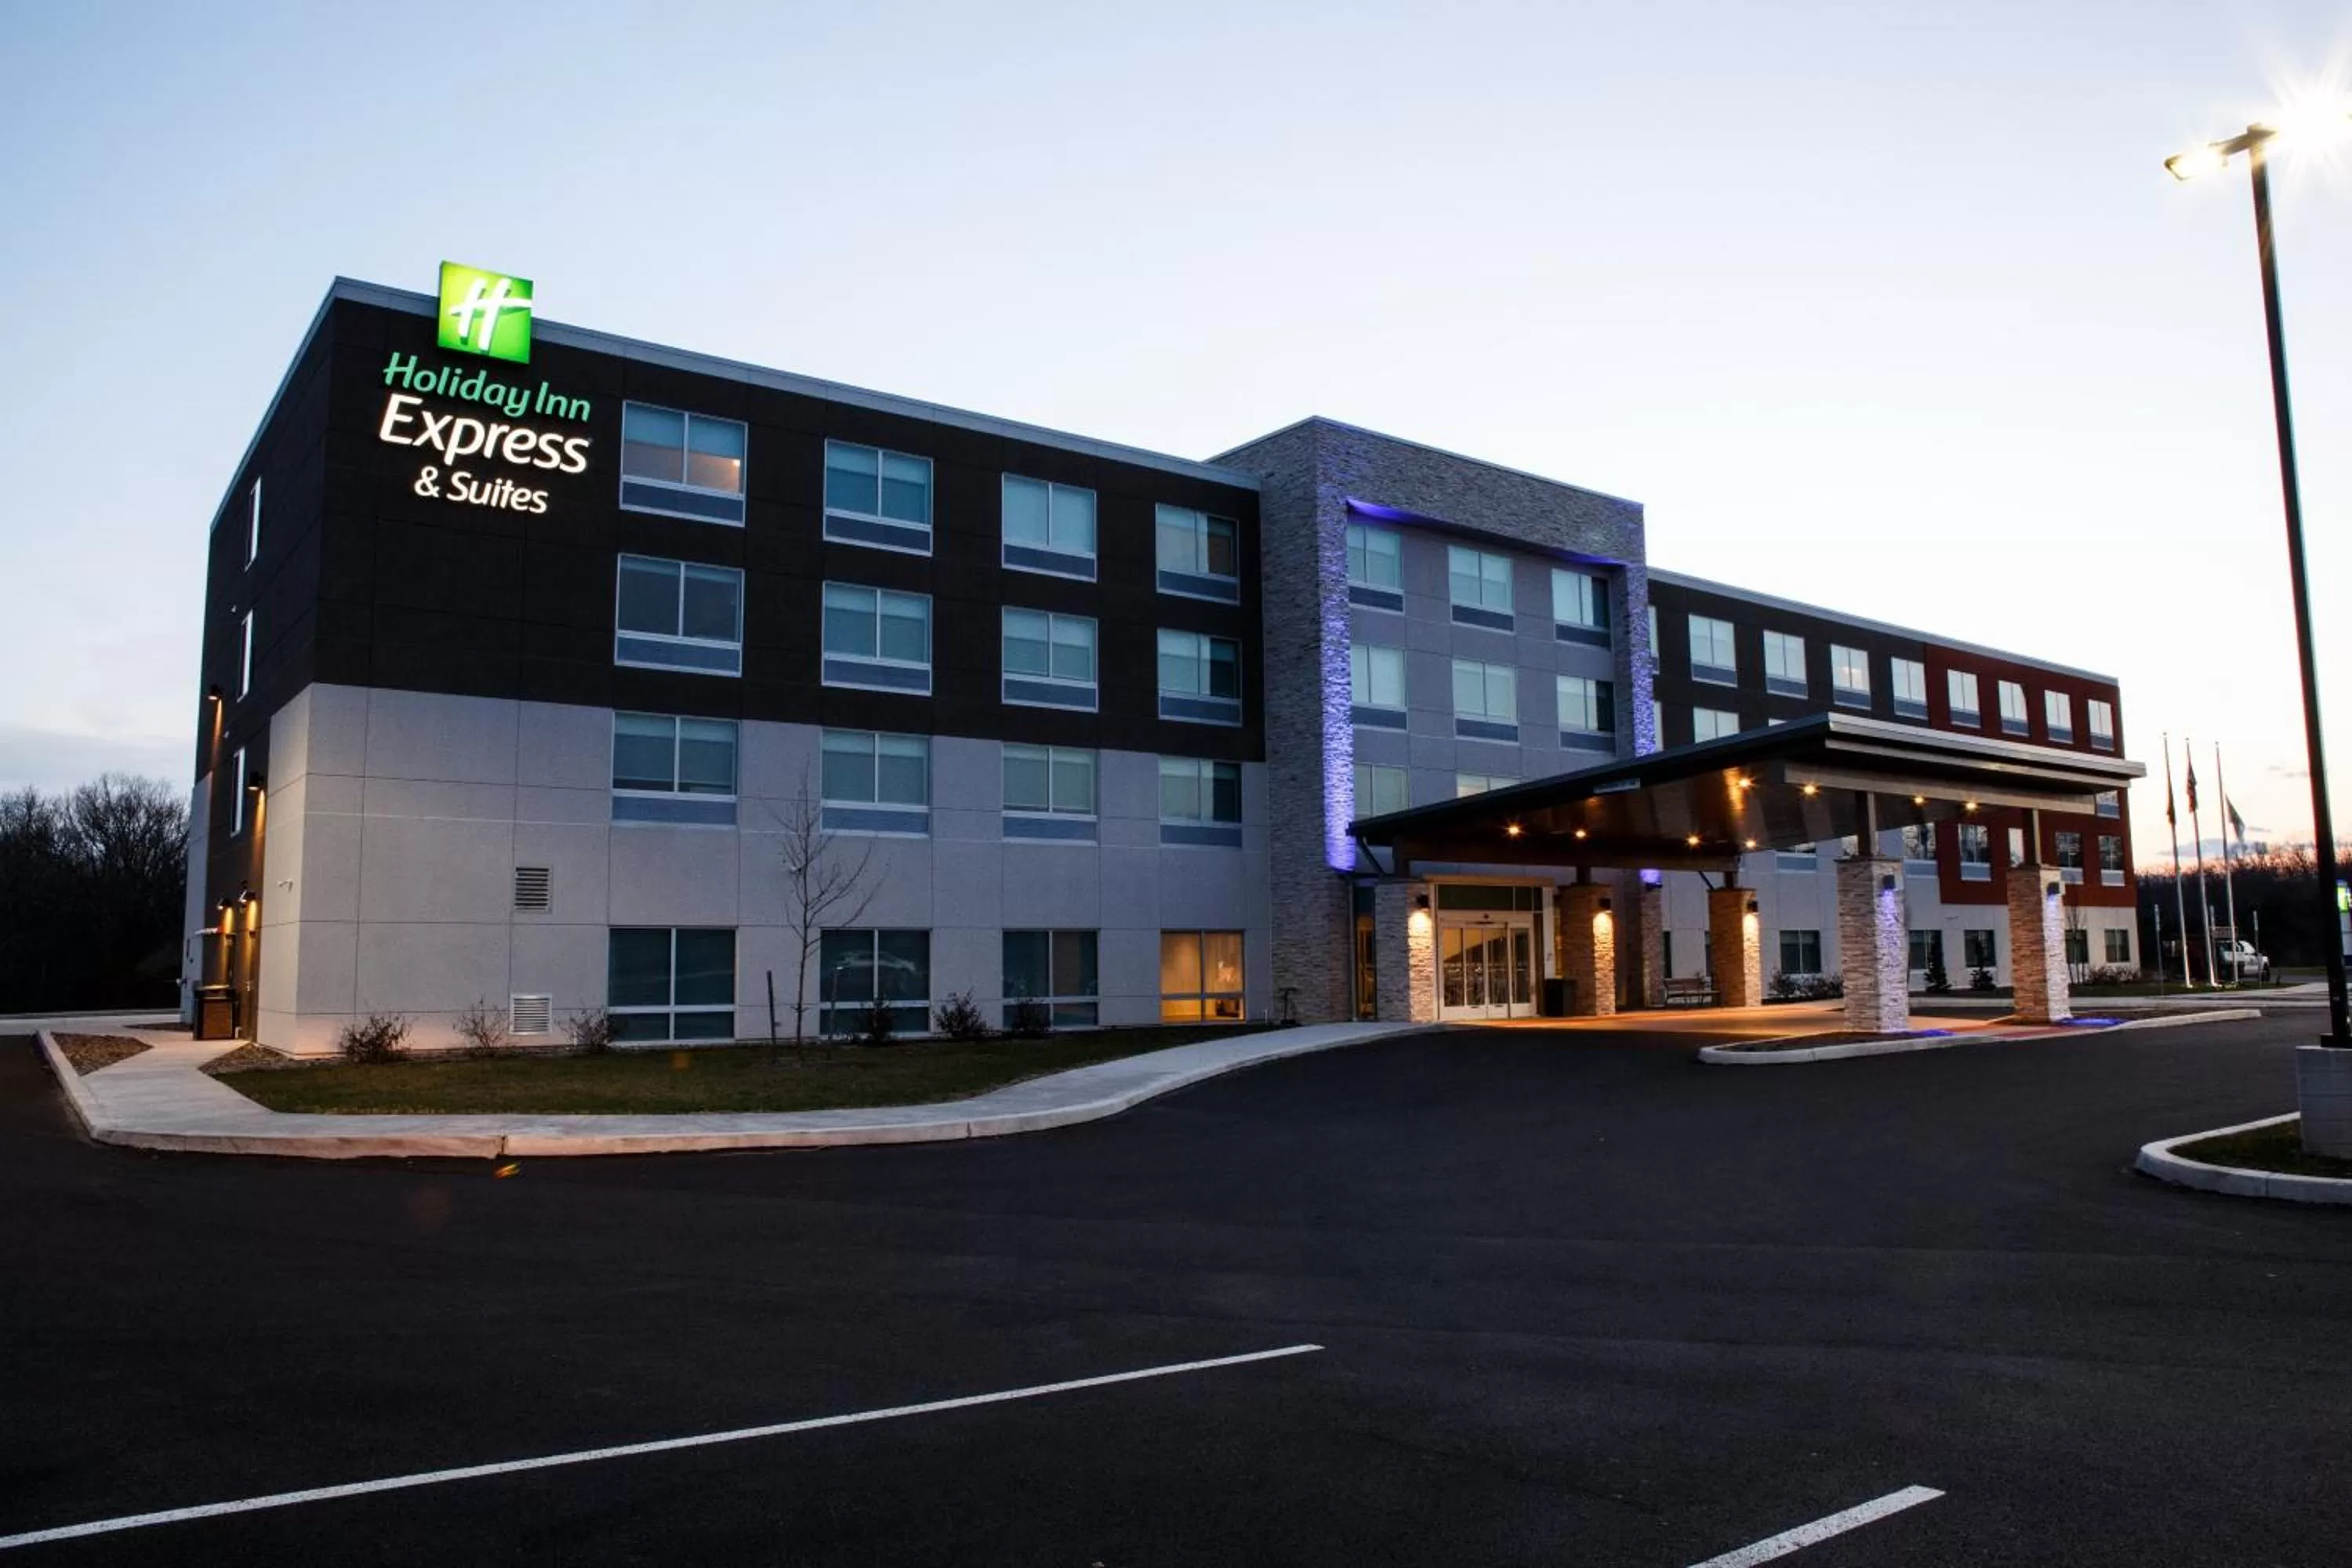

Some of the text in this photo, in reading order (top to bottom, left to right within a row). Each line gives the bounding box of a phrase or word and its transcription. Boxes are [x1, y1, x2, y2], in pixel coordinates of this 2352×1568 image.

[383, 351, 591, 423] Holiday Inn
[379, 393, 590, 474] Express
[414, 465, 549, 514] & Suites
